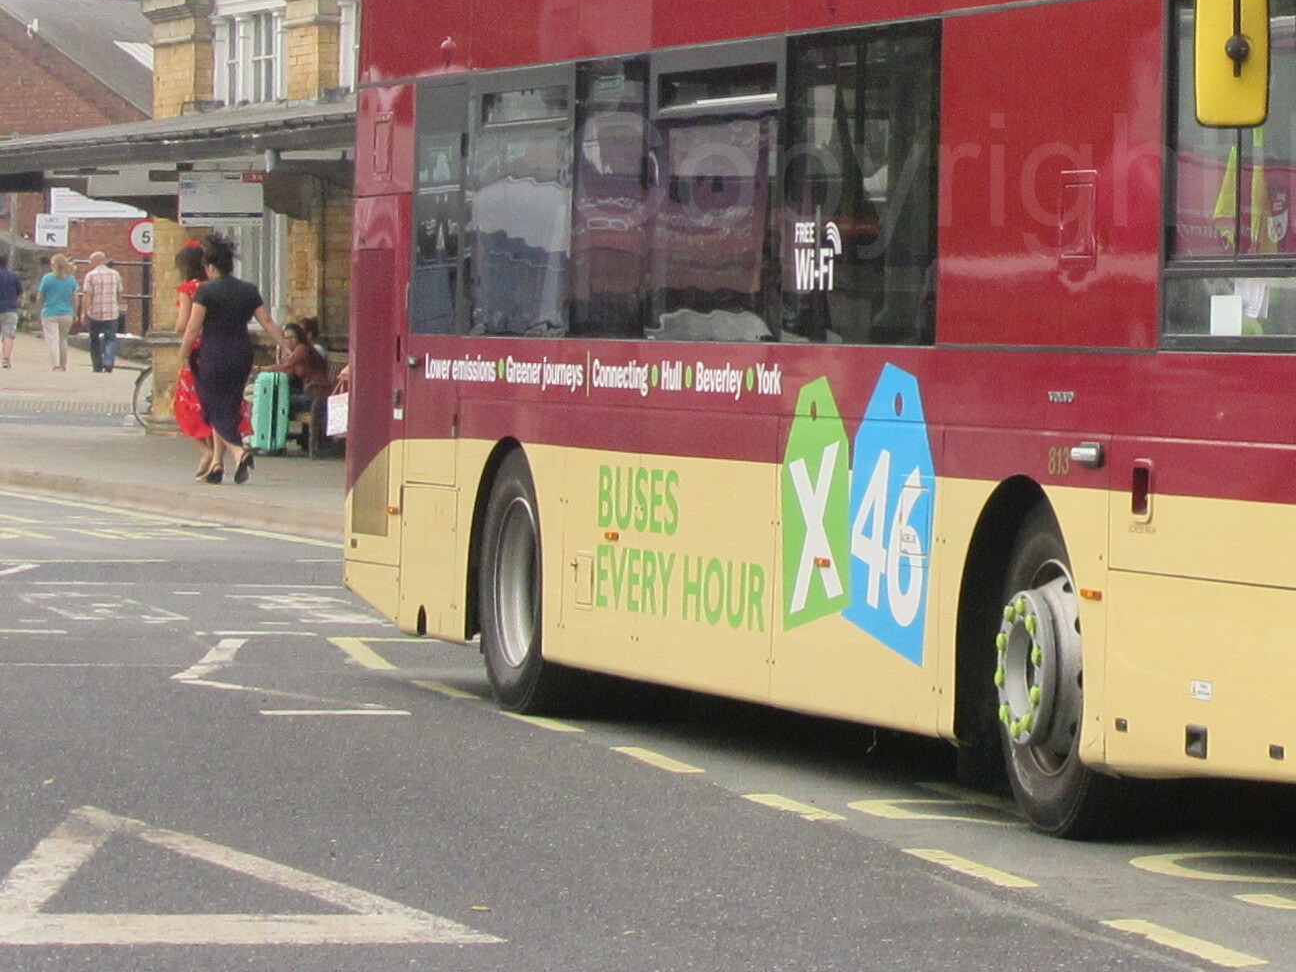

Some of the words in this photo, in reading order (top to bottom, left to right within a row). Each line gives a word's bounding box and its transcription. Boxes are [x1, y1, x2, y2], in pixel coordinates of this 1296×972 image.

[141, 231, 151, 244] 5
[794, 222, 815, 243] FREE
[794, 248, 833, 290] Wi-Fi
[425, 353, 450, 380] Lower
[452, 355, 496, 382] emissions
[506, 356, 542, 384] Greener
[541, 357, 583, 392] journeys
[592, 359, 649, 397] Connecting
[661, 361, 683, 391] Hull
[695, 363, 743, 401] Beverley
[755, 363, 782, 395] York
[1048, 446, 1070, 475] 813
[597, 464, 680, 536] BUSES
[595, 544, 677, 617] EVERY
[682, 553, 765, 633] HOUR
